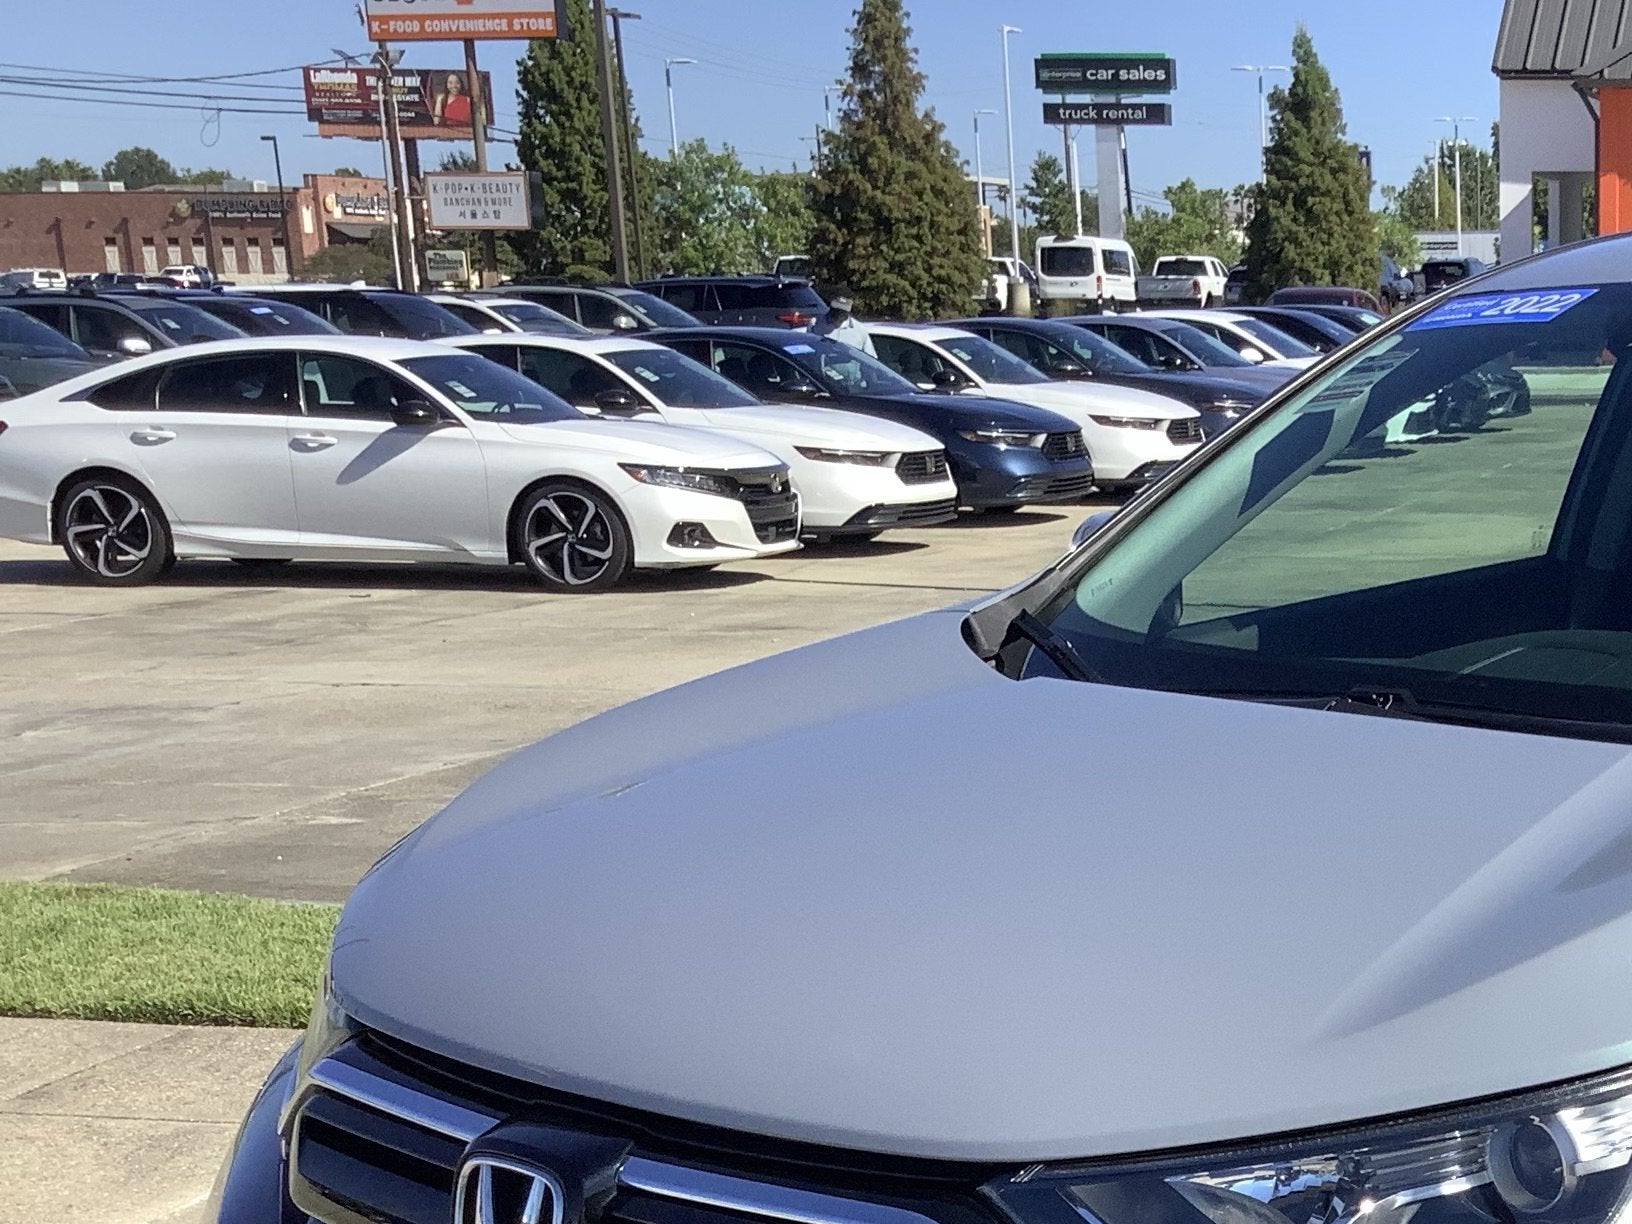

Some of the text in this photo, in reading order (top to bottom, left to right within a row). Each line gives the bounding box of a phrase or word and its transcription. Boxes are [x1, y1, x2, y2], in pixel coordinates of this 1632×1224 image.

[424, 18, 509, 32] CONVENIENCE
[512, 17, 554, 31] STORE
[1086, 69, 1114, 80] car
[1119, 65, 1166, 80] sales
[1058, 106, 1147, 119] truck rental
[1480, 293, 1582, 316] 2022
